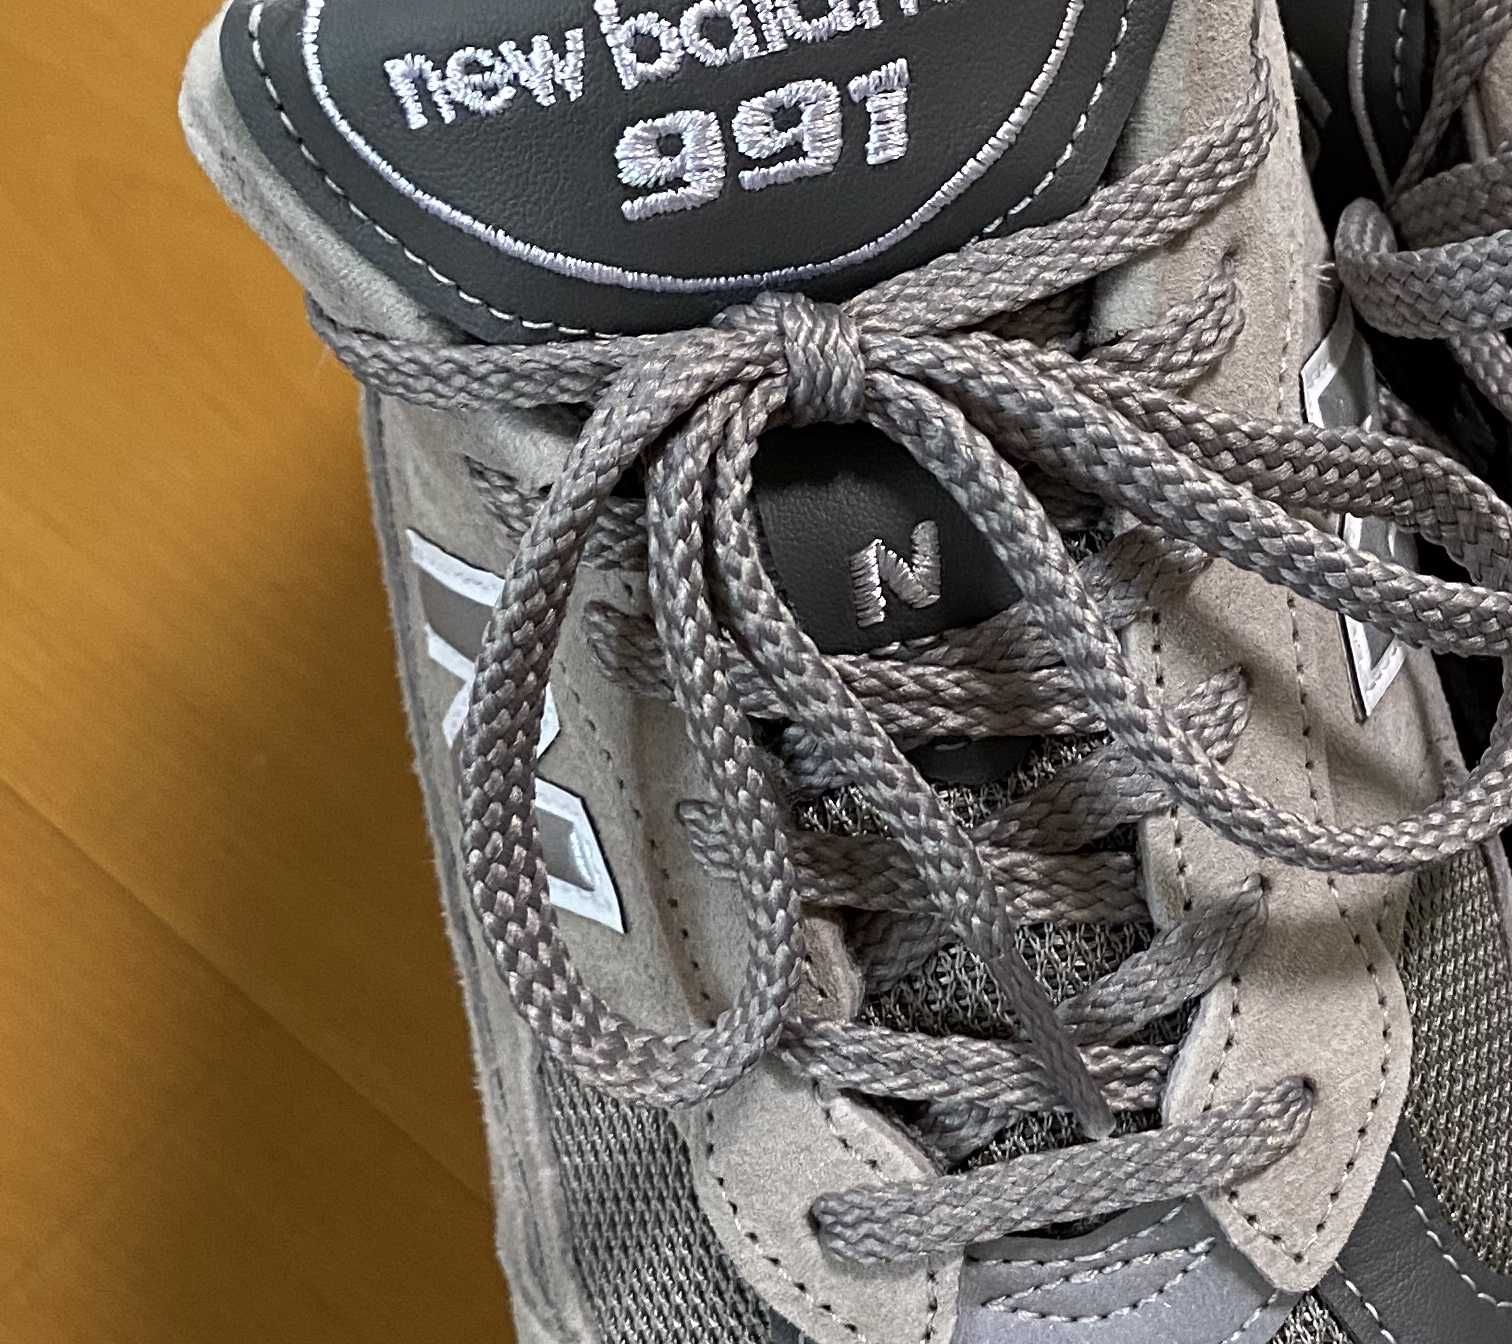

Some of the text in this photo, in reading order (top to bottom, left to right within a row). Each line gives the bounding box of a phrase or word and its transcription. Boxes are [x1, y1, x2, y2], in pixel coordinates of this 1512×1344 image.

[384, 27, 584, 130] new
[613, 58, 912, 222] 991
[849, 520, 941, 628] N
